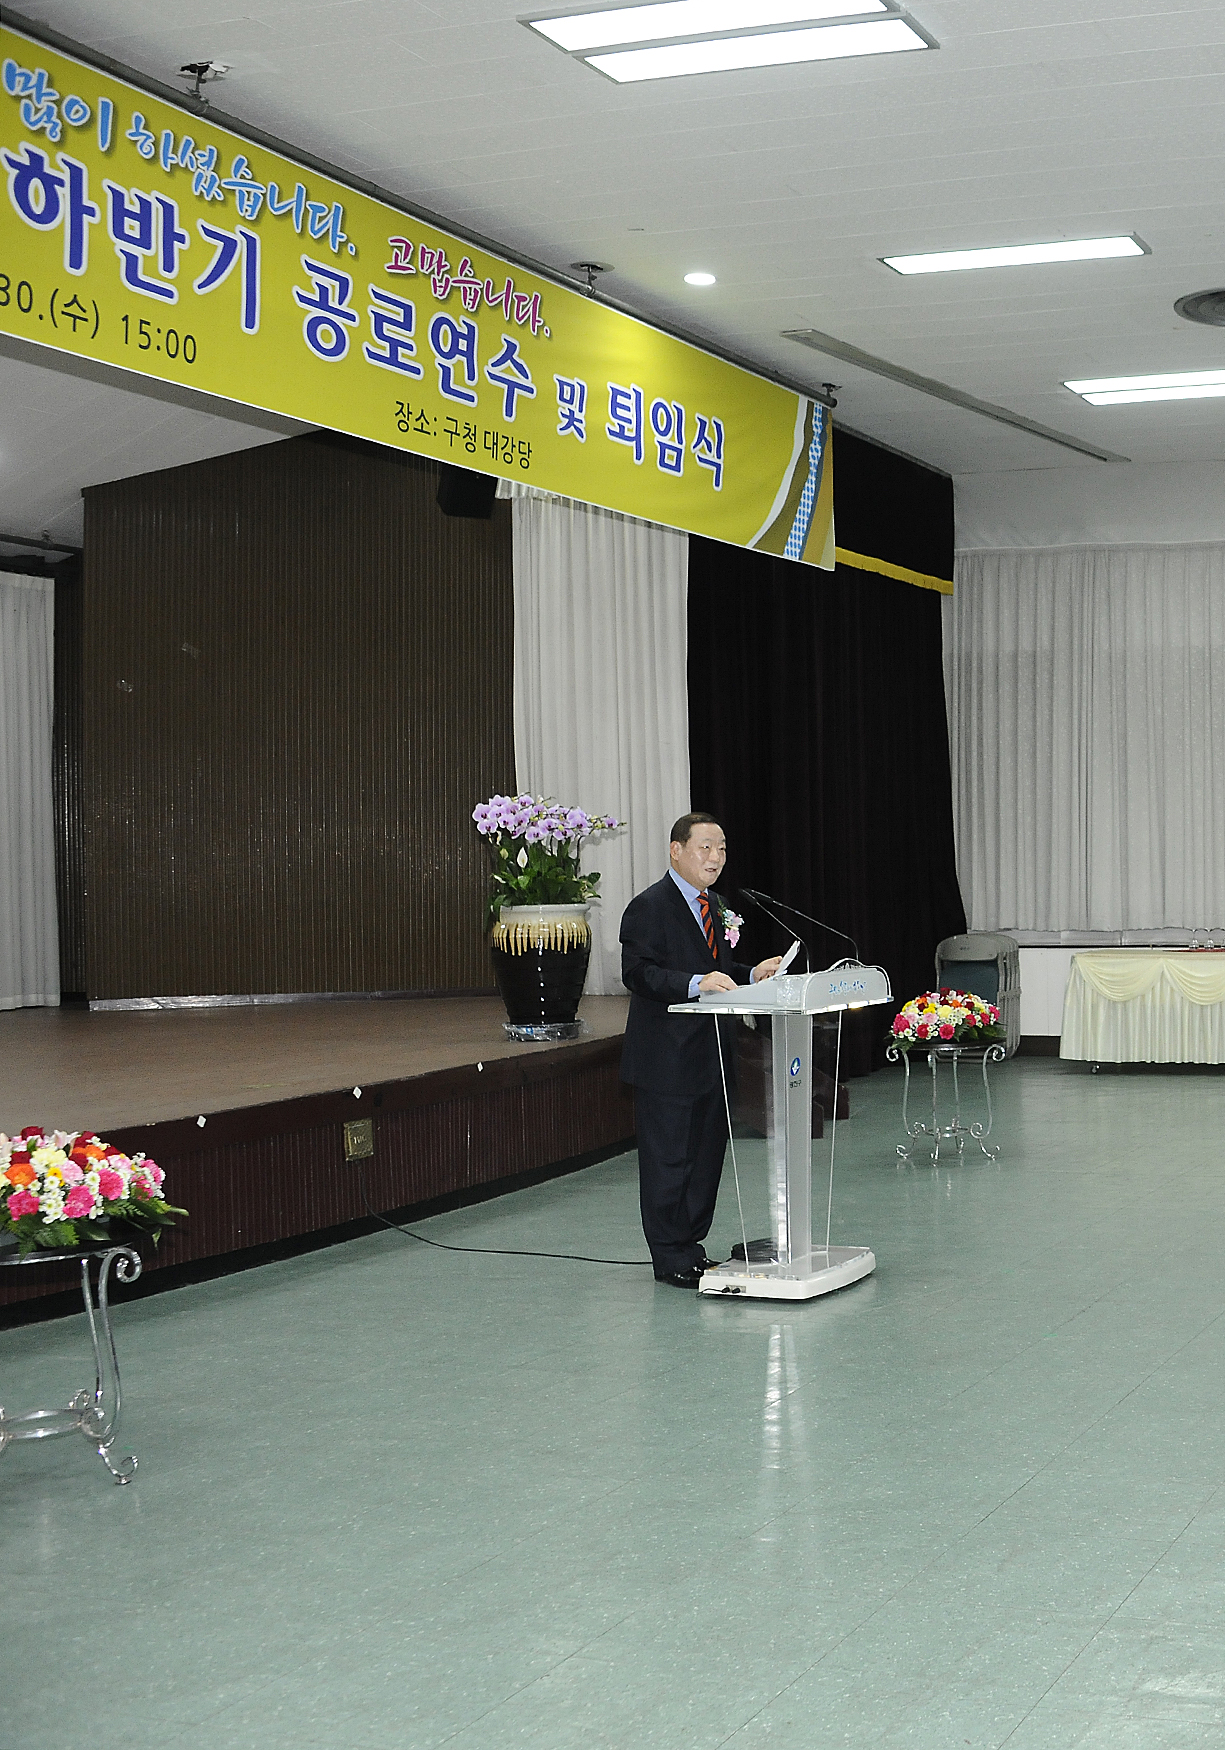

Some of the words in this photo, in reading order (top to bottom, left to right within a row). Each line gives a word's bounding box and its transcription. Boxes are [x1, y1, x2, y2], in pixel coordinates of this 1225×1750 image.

[3, 60, 113, 150] 많이
[127, 113, 355, 254] 하셨습니다.
[385, 237, 550, 335] 고맙습니다.
[3, 149, 258, 331] 하반기
[294, 258, 536, 419] 공로연수
[555, 377, 587, 440] 및
[606, 384, 724, 489] 퇴임식
[121, 314, 197, 364] 15:00
[394, 400, 438, 437] 장소:
[443, 416, 477, 454] 구청
[483, 430, 533, 470] 대강당
